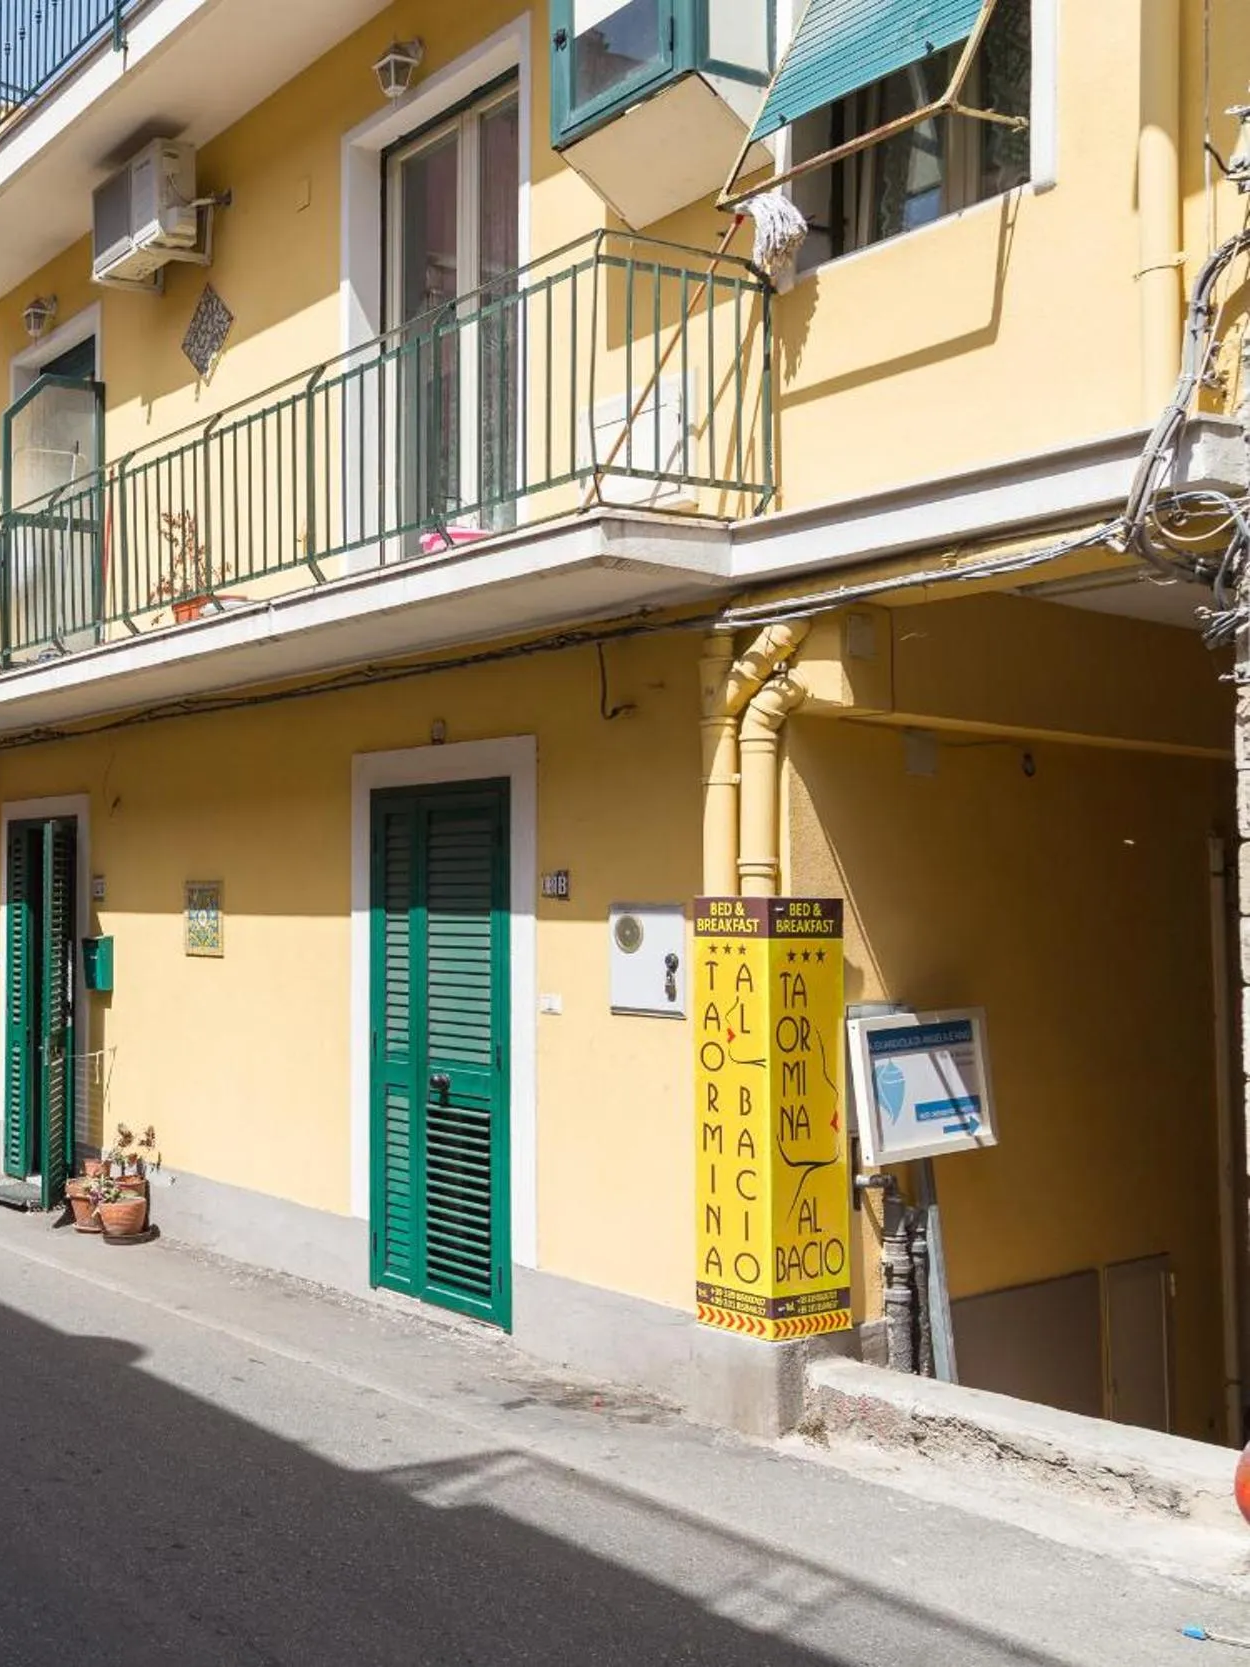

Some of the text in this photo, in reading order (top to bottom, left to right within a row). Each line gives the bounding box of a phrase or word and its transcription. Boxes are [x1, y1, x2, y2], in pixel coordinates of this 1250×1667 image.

[696, 918, 760, 932] BREAKFAST
[710, 902, 746, 916] BED &
[776, 920, 834, 932] BREAKFAST
[789, 903, 823, 916] BED &
[779, 971, 808, 1009] TA
[776, 1015, 811, 1053] OR
[782, 1060, 807, 1097] MI
[700, 961, 725, 1277] TAORMINA
[780, 1104, 811, 1142] NA
[798, 1197, 822, 1236] AL
[776, 1238, 845, 1284] BACIO
